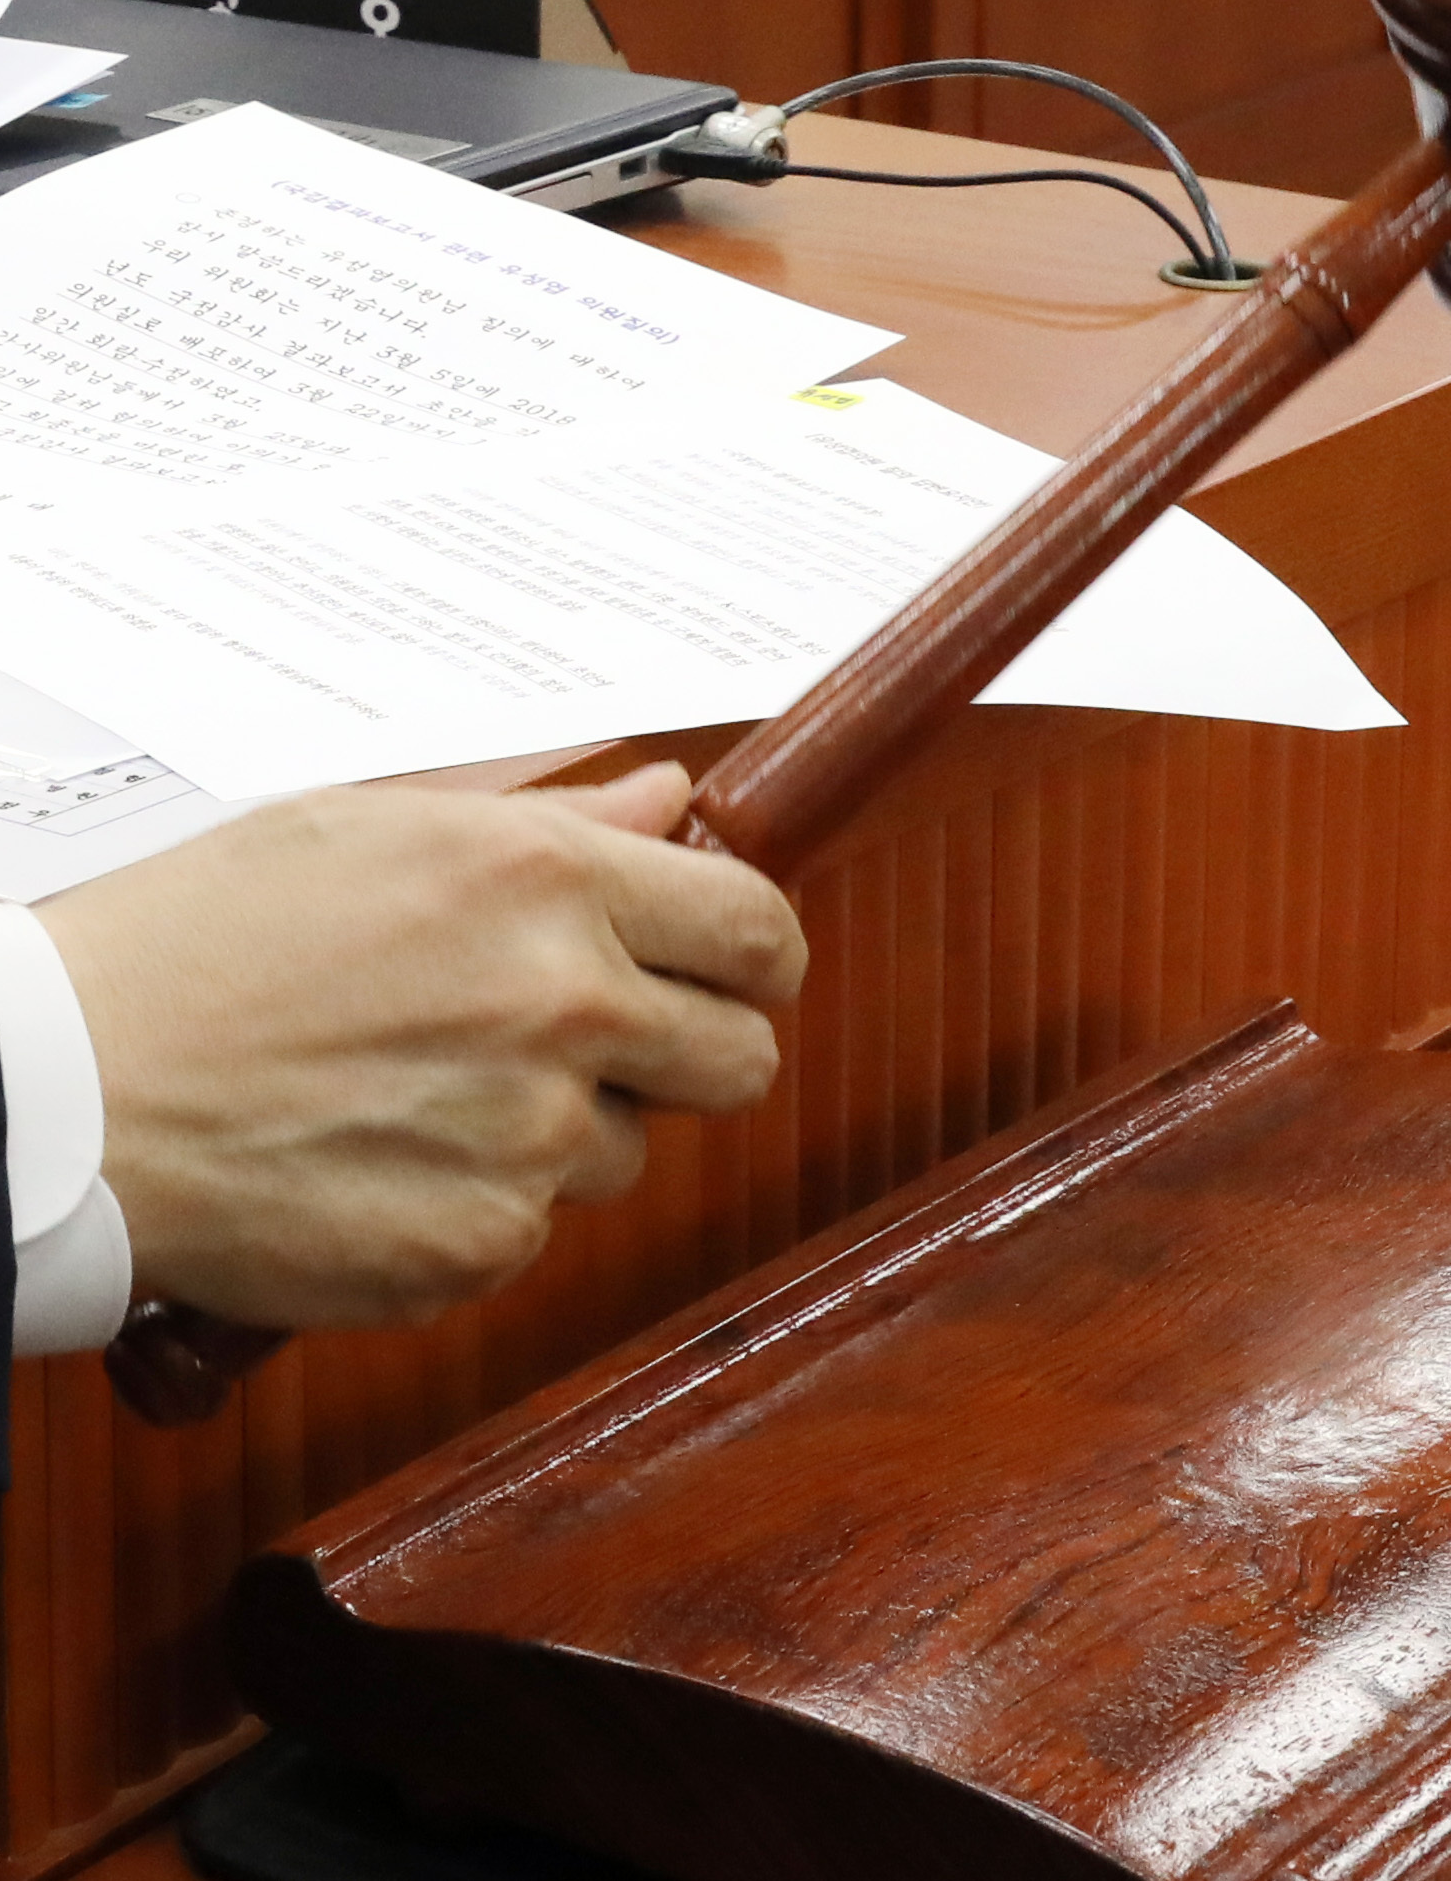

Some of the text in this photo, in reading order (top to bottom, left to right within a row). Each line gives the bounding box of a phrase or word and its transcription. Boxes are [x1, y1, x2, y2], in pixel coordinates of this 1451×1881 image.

[32, 306, 81, 335] 일간
[141, 239, 577, 426] 우리 위원회는 지난 3월 5일에 2018
[174, 221, 430, 339] 잠시 말씀드리겠습니다.
[213, 207, 647, 392] 존경하는 유성엽의원님 질의에 대하여
[270, 180, 681, 345] (국감결과보고서 관련 유성엽 의원질의)
[49, 389, 102, 412] 걸쳐
[111, 410, 213, 443] 협의하여
[66, 282, 457, 440] 의원실로 배포하여 3월 22일까지
[105, 258, 500, 430] 년도 국정감사 결과보고서 초안을
[201, 413, 249, 431] 3월
[265, 430, 351, 456] 23일과
